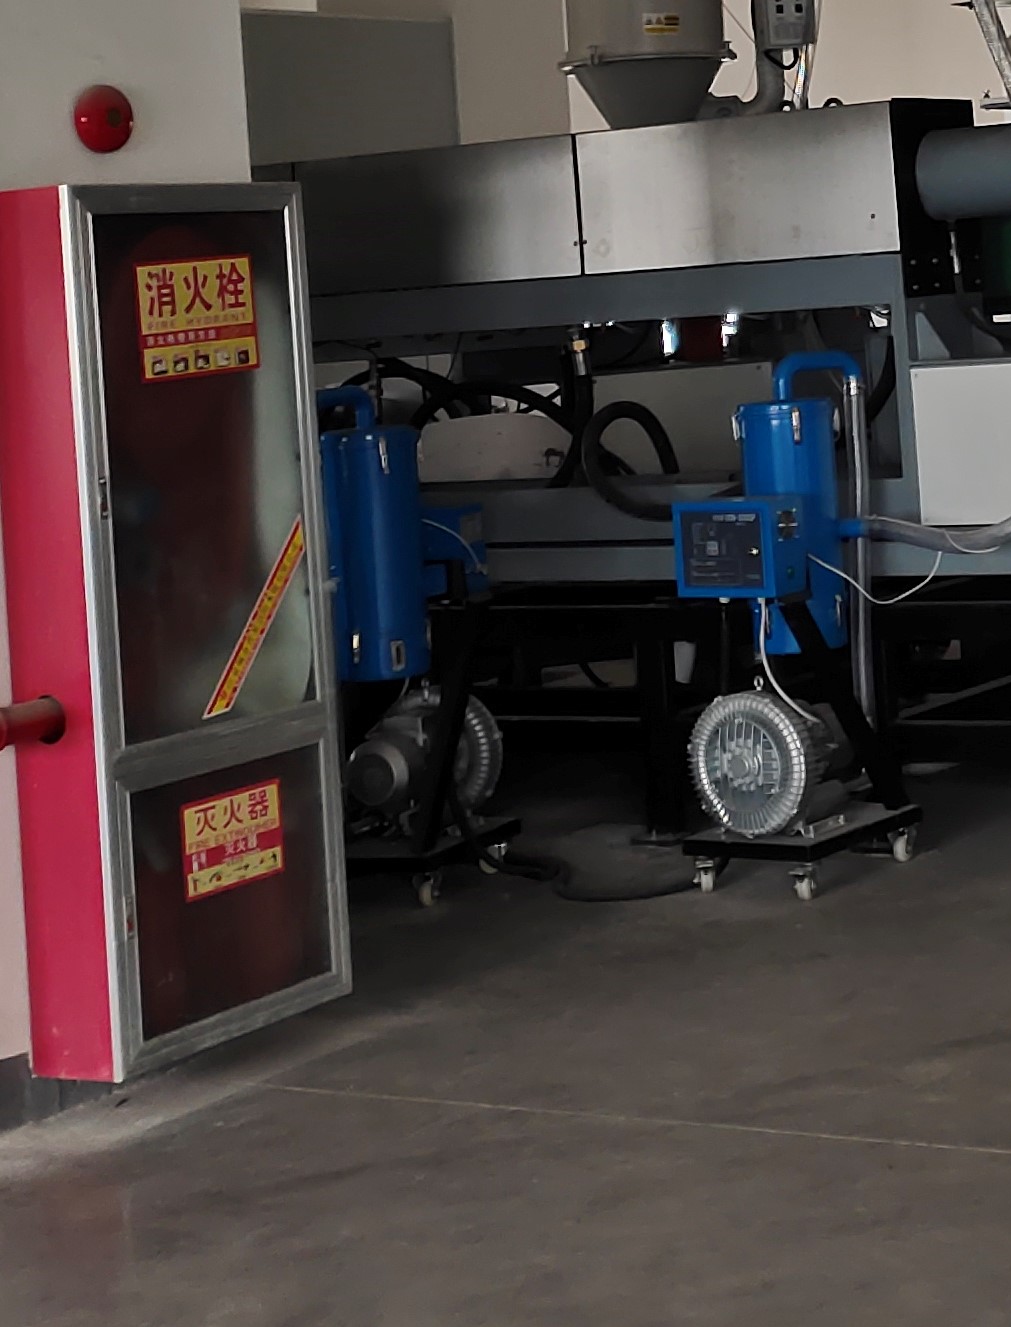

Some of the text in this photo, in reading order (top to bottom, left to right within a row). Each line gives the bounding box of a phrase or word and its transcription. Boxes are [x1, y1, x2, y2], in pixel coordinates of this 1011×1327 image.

[145, 262, 247, 318] 消火栓
[194, 789, 269, 837] 灭火器
